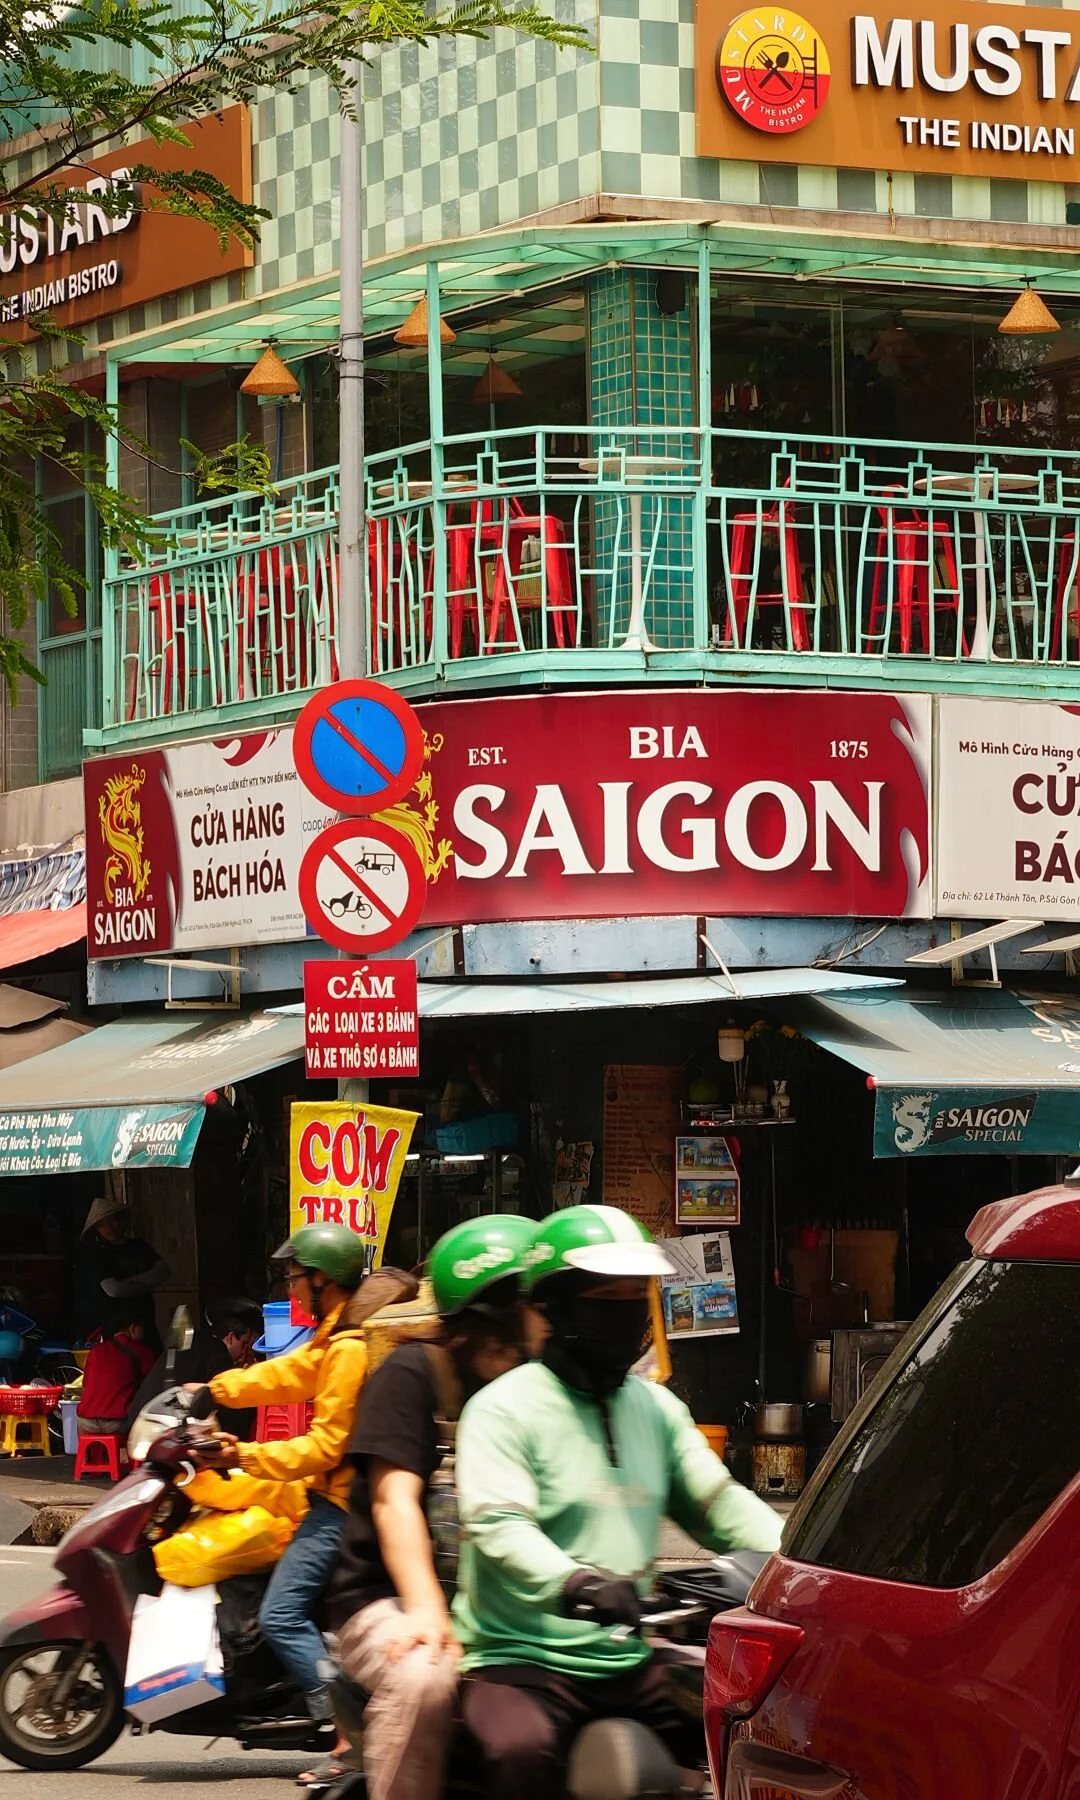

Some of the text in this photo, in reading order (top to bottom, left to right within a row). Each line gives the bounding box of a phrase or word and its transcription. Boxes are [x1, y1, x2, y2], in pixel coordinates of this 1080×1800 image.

[725, 15, 806, 113] MUSTARD
[854, 15, 1080, 101] MUST
[760, 98, 806, 116] THE INDIAN
[768, 113, 803, 127] BISTRO
[899, 116, 1075, 155] THE INDIAN
[0, 259, 119, 323] HE INDIAN BISTRO
[468, 725, 869, 767] EST. BIA 1875
[959, 741, 978, 754] Mô
[981, 742, 1009, 755] Hình
[1012, 743, 1038, 756] Cửa
[1041, 744, 1075, 761] Hàng
[1012, 762, 1080, 816] CỬ
[190, 796, 285, 848] CỬA HÀNG
[453, 780, 886, 880] SAIGON
[1015, 830, 1080, 884] BÁ
[193, 849, 287, 902] BÁCH HÓA
[115, 886, 134, 908] BIA
[973, 892, 983, 901] 62
[94, 907, 156, 945] SAIGON
[327, 965, 396, 999] CẤM
[308, 1005, 415, 1039] CÁC LOẠI XE 3 BÁNH
[306, 1041, 321, 1068] VÀ
[323, 1047, 337, 1068] XE
[340, 1041, 361, 1068] THÔ
[380, 1048, 386, 1067] 4
[388, 1041, 417, 1067] BÁNH
[41, 1113, 56, 1128] Pha
[140, 1122, 187, 1143] SAIGON
[935, 1108, 1031, 1128] BIA SAIGON
[964, 1129, 1025, 1142] SPECIAL
[145, 1144, 178, 1157] SPECIAL
[298, 1111, 401, 1193] CƠM
[298, 1192, 379, 1238] TRƯA
